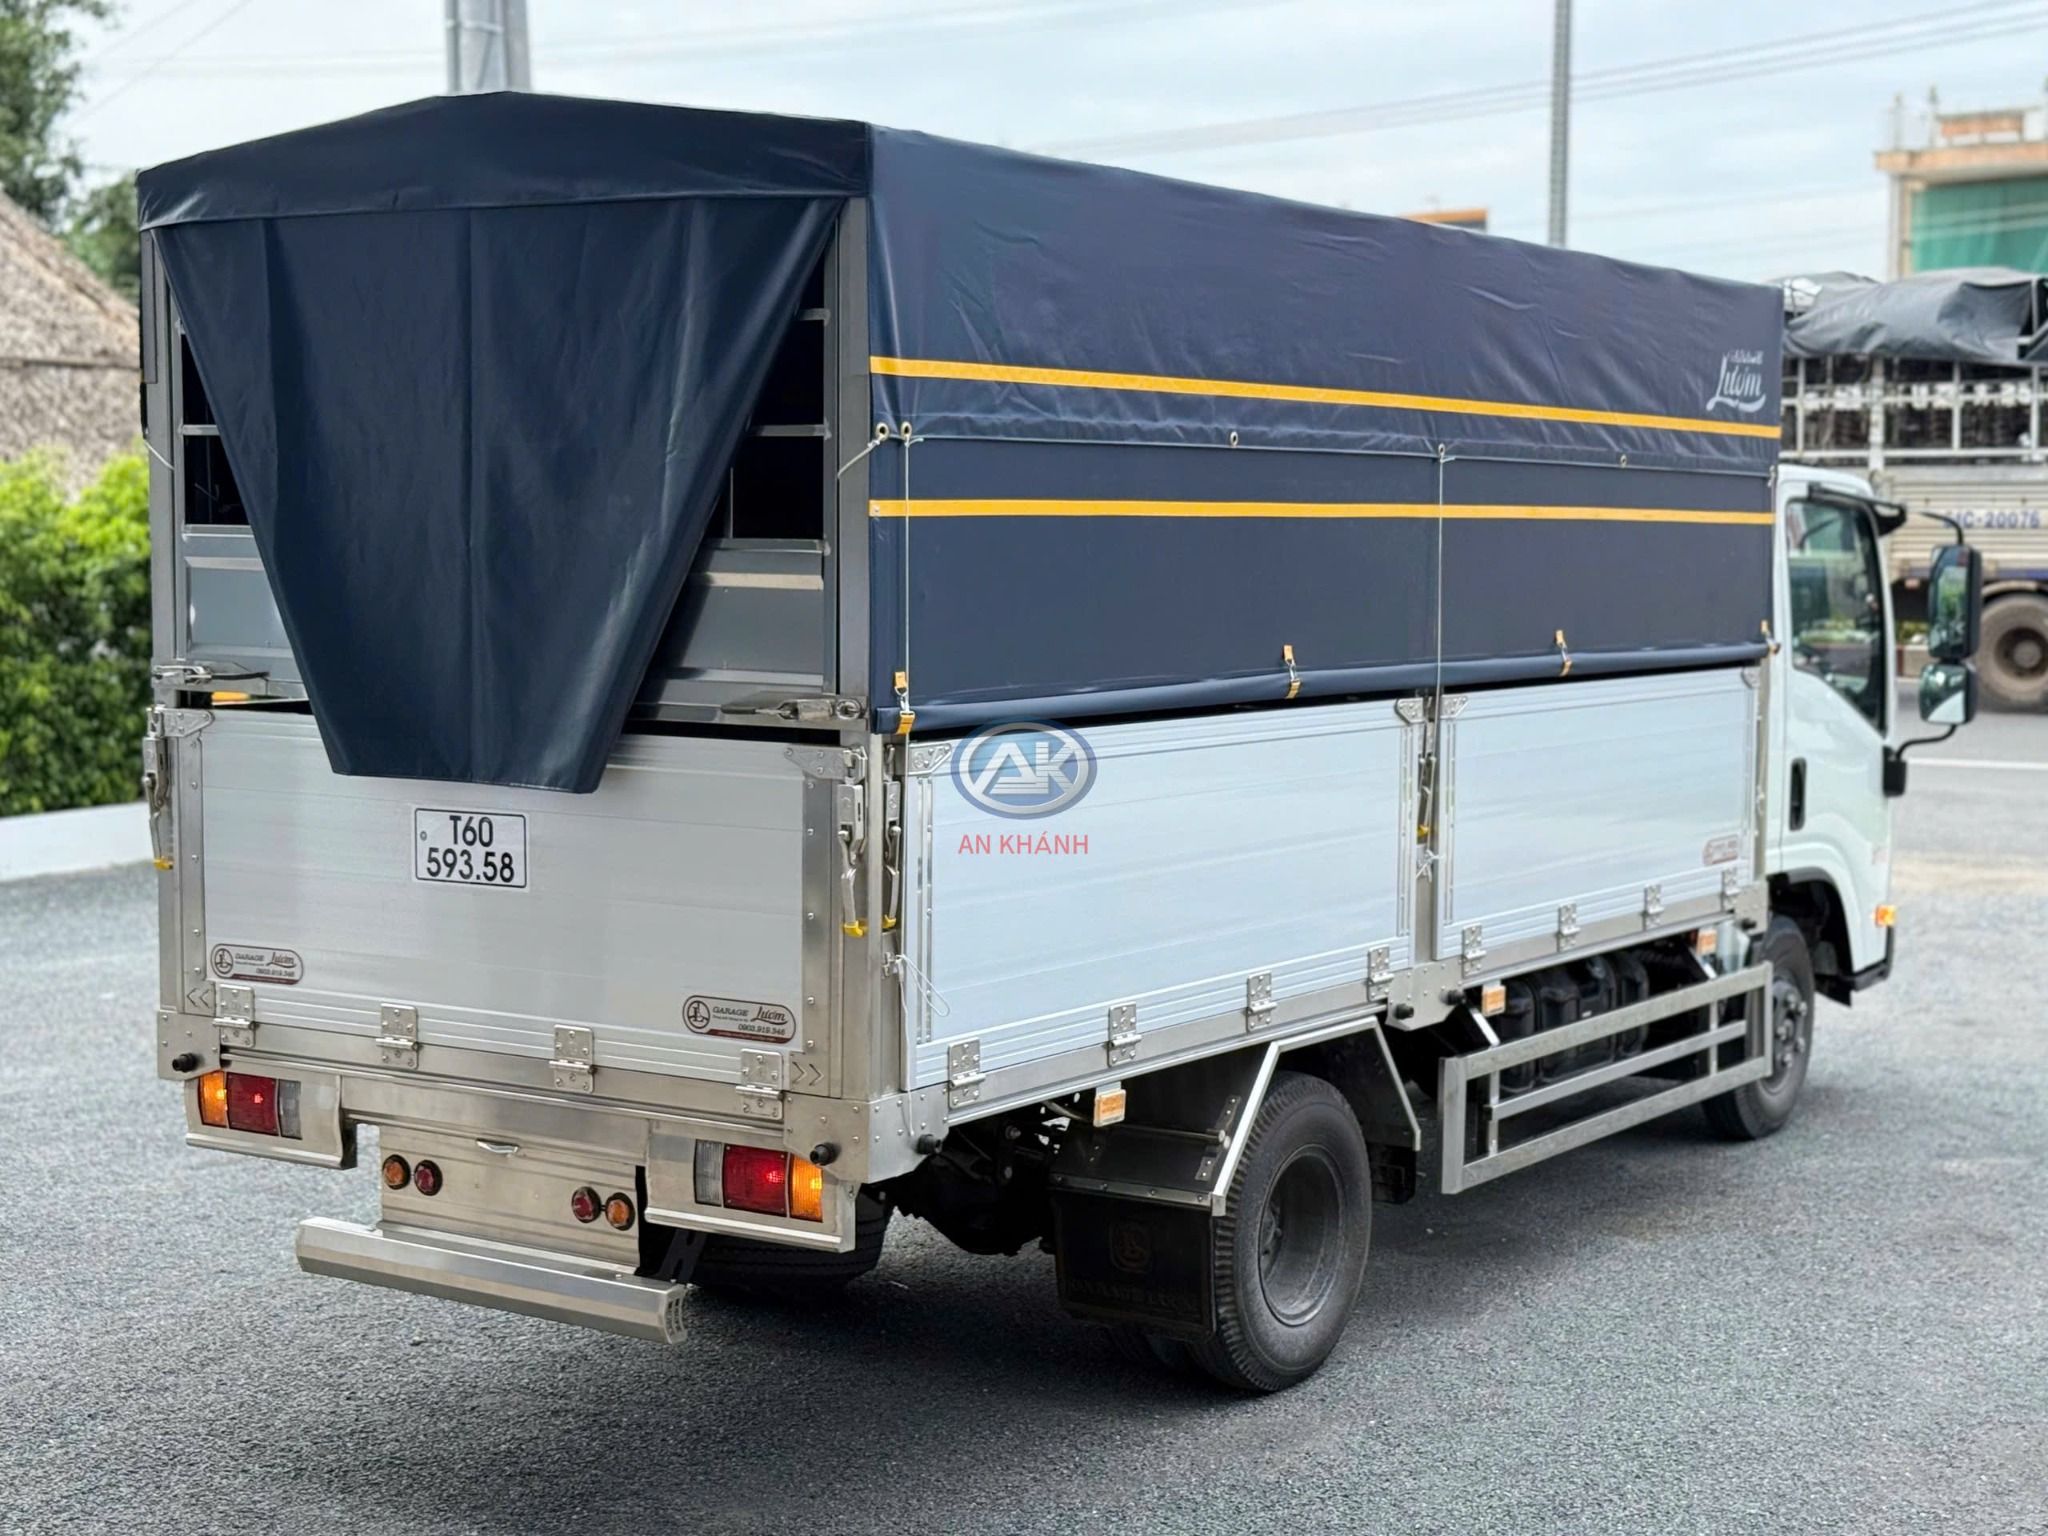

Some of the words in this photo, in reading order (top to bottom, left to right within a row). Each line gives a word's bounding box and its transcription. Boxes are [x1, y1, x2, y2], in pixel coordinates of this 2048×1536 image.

[449, 814, 493, 848] T60
[426, 847, 515, 883] 593.58
[711, 1006, 749, 1017] GARAGE
